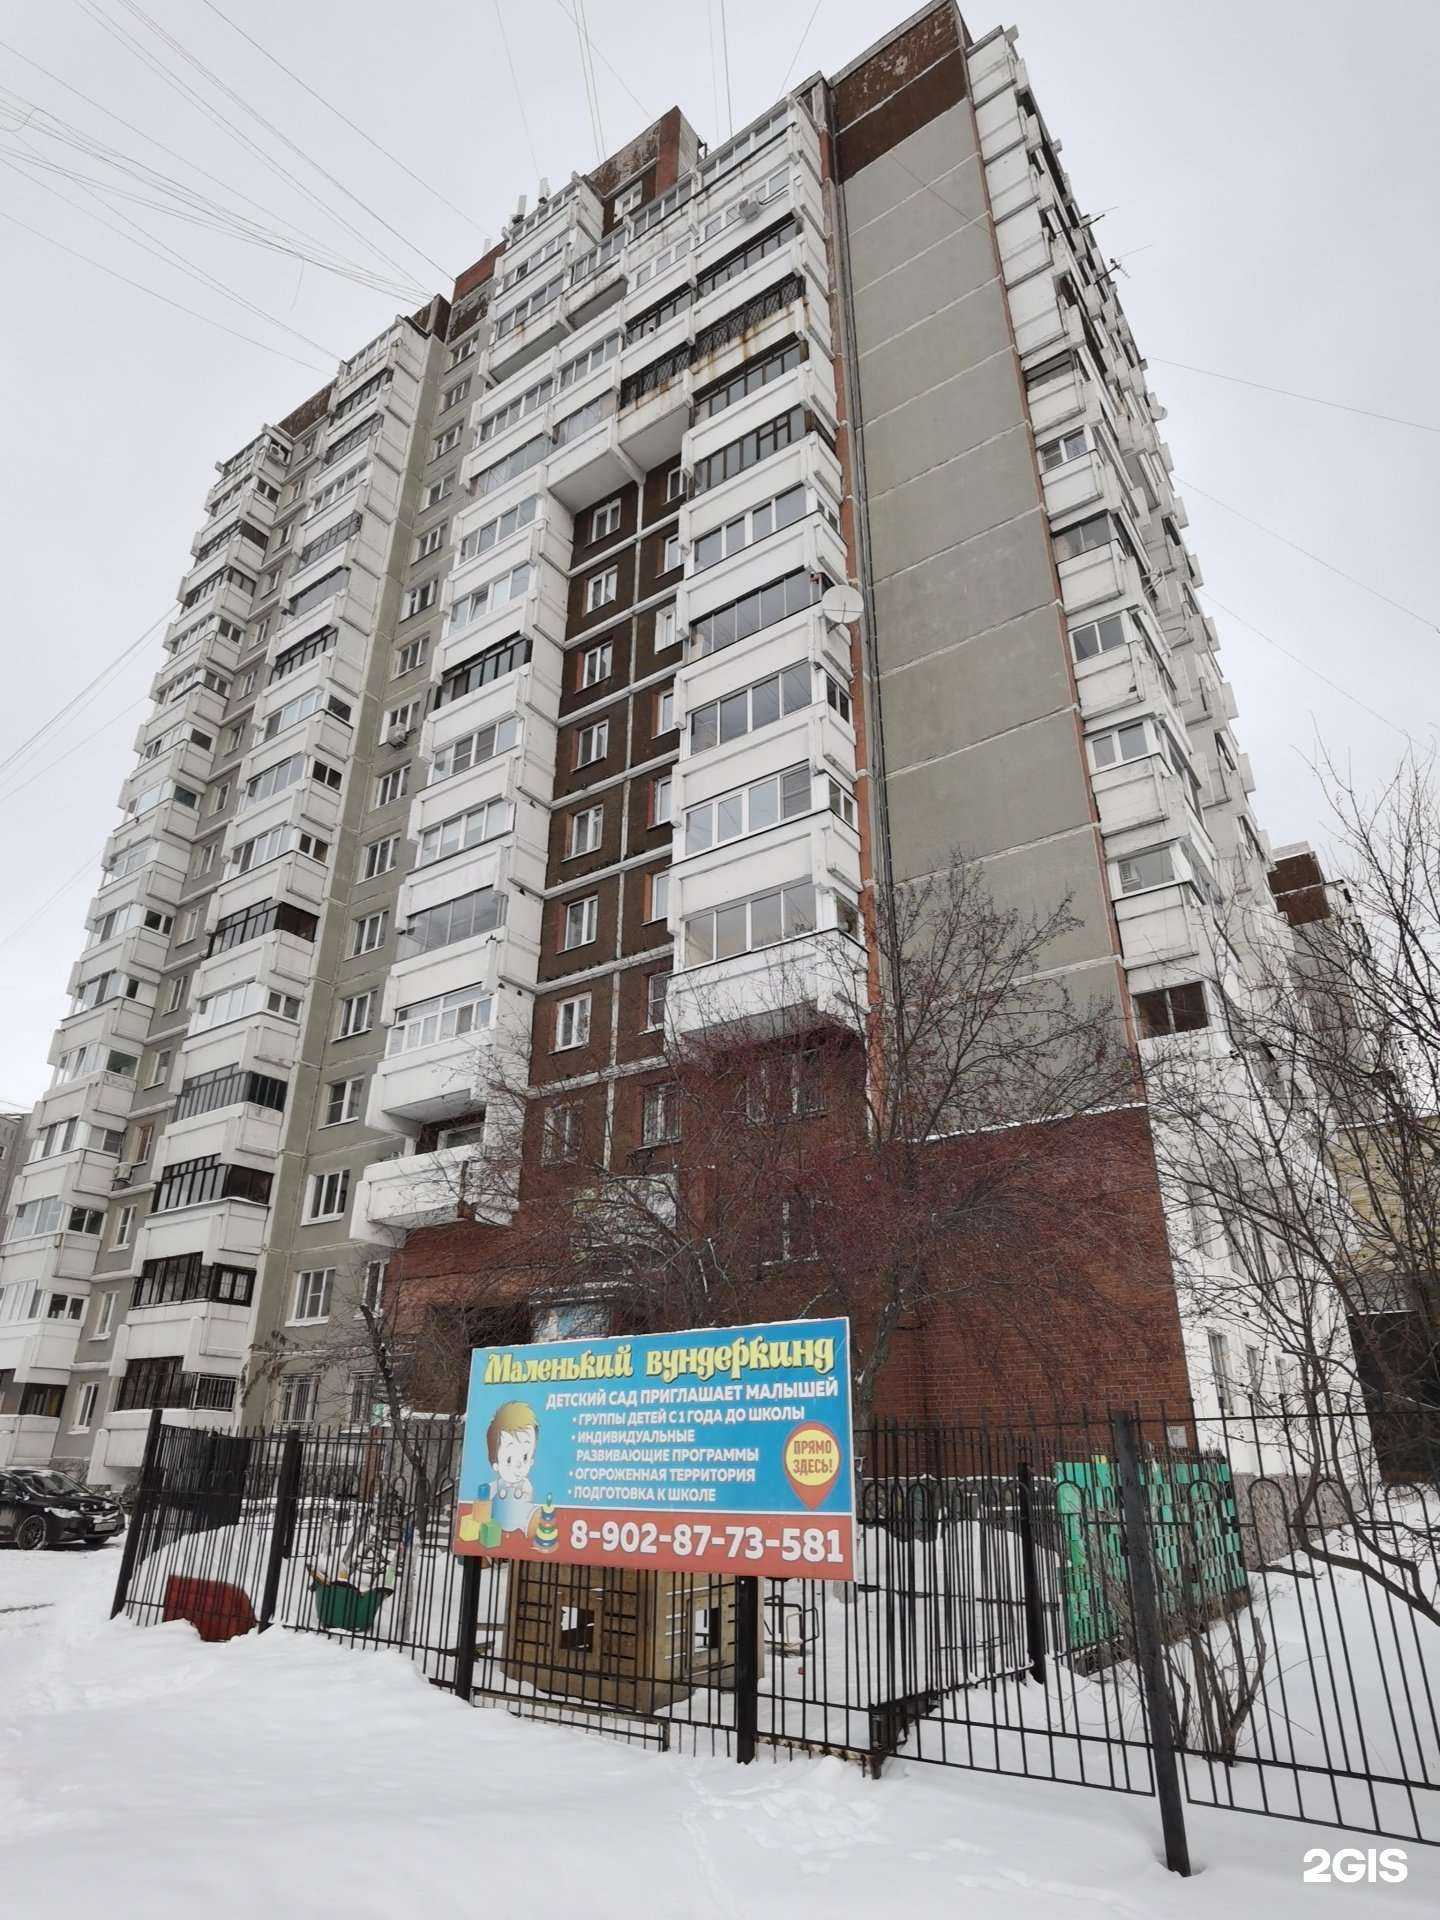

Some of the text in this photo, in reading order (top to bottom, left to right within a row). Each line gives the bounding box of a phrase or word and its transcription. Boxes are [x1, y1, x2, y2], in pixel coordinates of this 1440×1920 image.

[484, 1336, 835, 1384] Маленький вундеркинд
[545, 1376, 839, 1411] ДЕТСКИЙ САД ПРИГЛАШАЕТ МАЛЫШЕЙ
[579, 1412, 626, 1426] ГРУППЫ
[627, 1408, 667, 1427] ДЕТЕЙ
[687, 1408, 723, 1425] ГОДА
[725, 1407, 746, 1425] ДО
[748, 1406, 805, 1421] ШКОЛЫ
[577, 1429, 696, 1445] ИНДИВИДУАЛЬНЫЕ
[794, 1439, 832, 1455] ПРЯМО
[576, 1448, 760, 1464] РАЗВИВАЮЩИЕ ПРОГРАММЫ
[574, 1468, 756, 1483] ОГОРОЖЕННАЯ ТЕРРИТОРИЯ
[793, 1458, 833, 1476] ЗДЕСЬ!
[574, 1486, 717, 1502] ПОДГОТОВКА К ШКОЛЕ
[570, 1519, 844, 1563] 8-902-87-73-581
